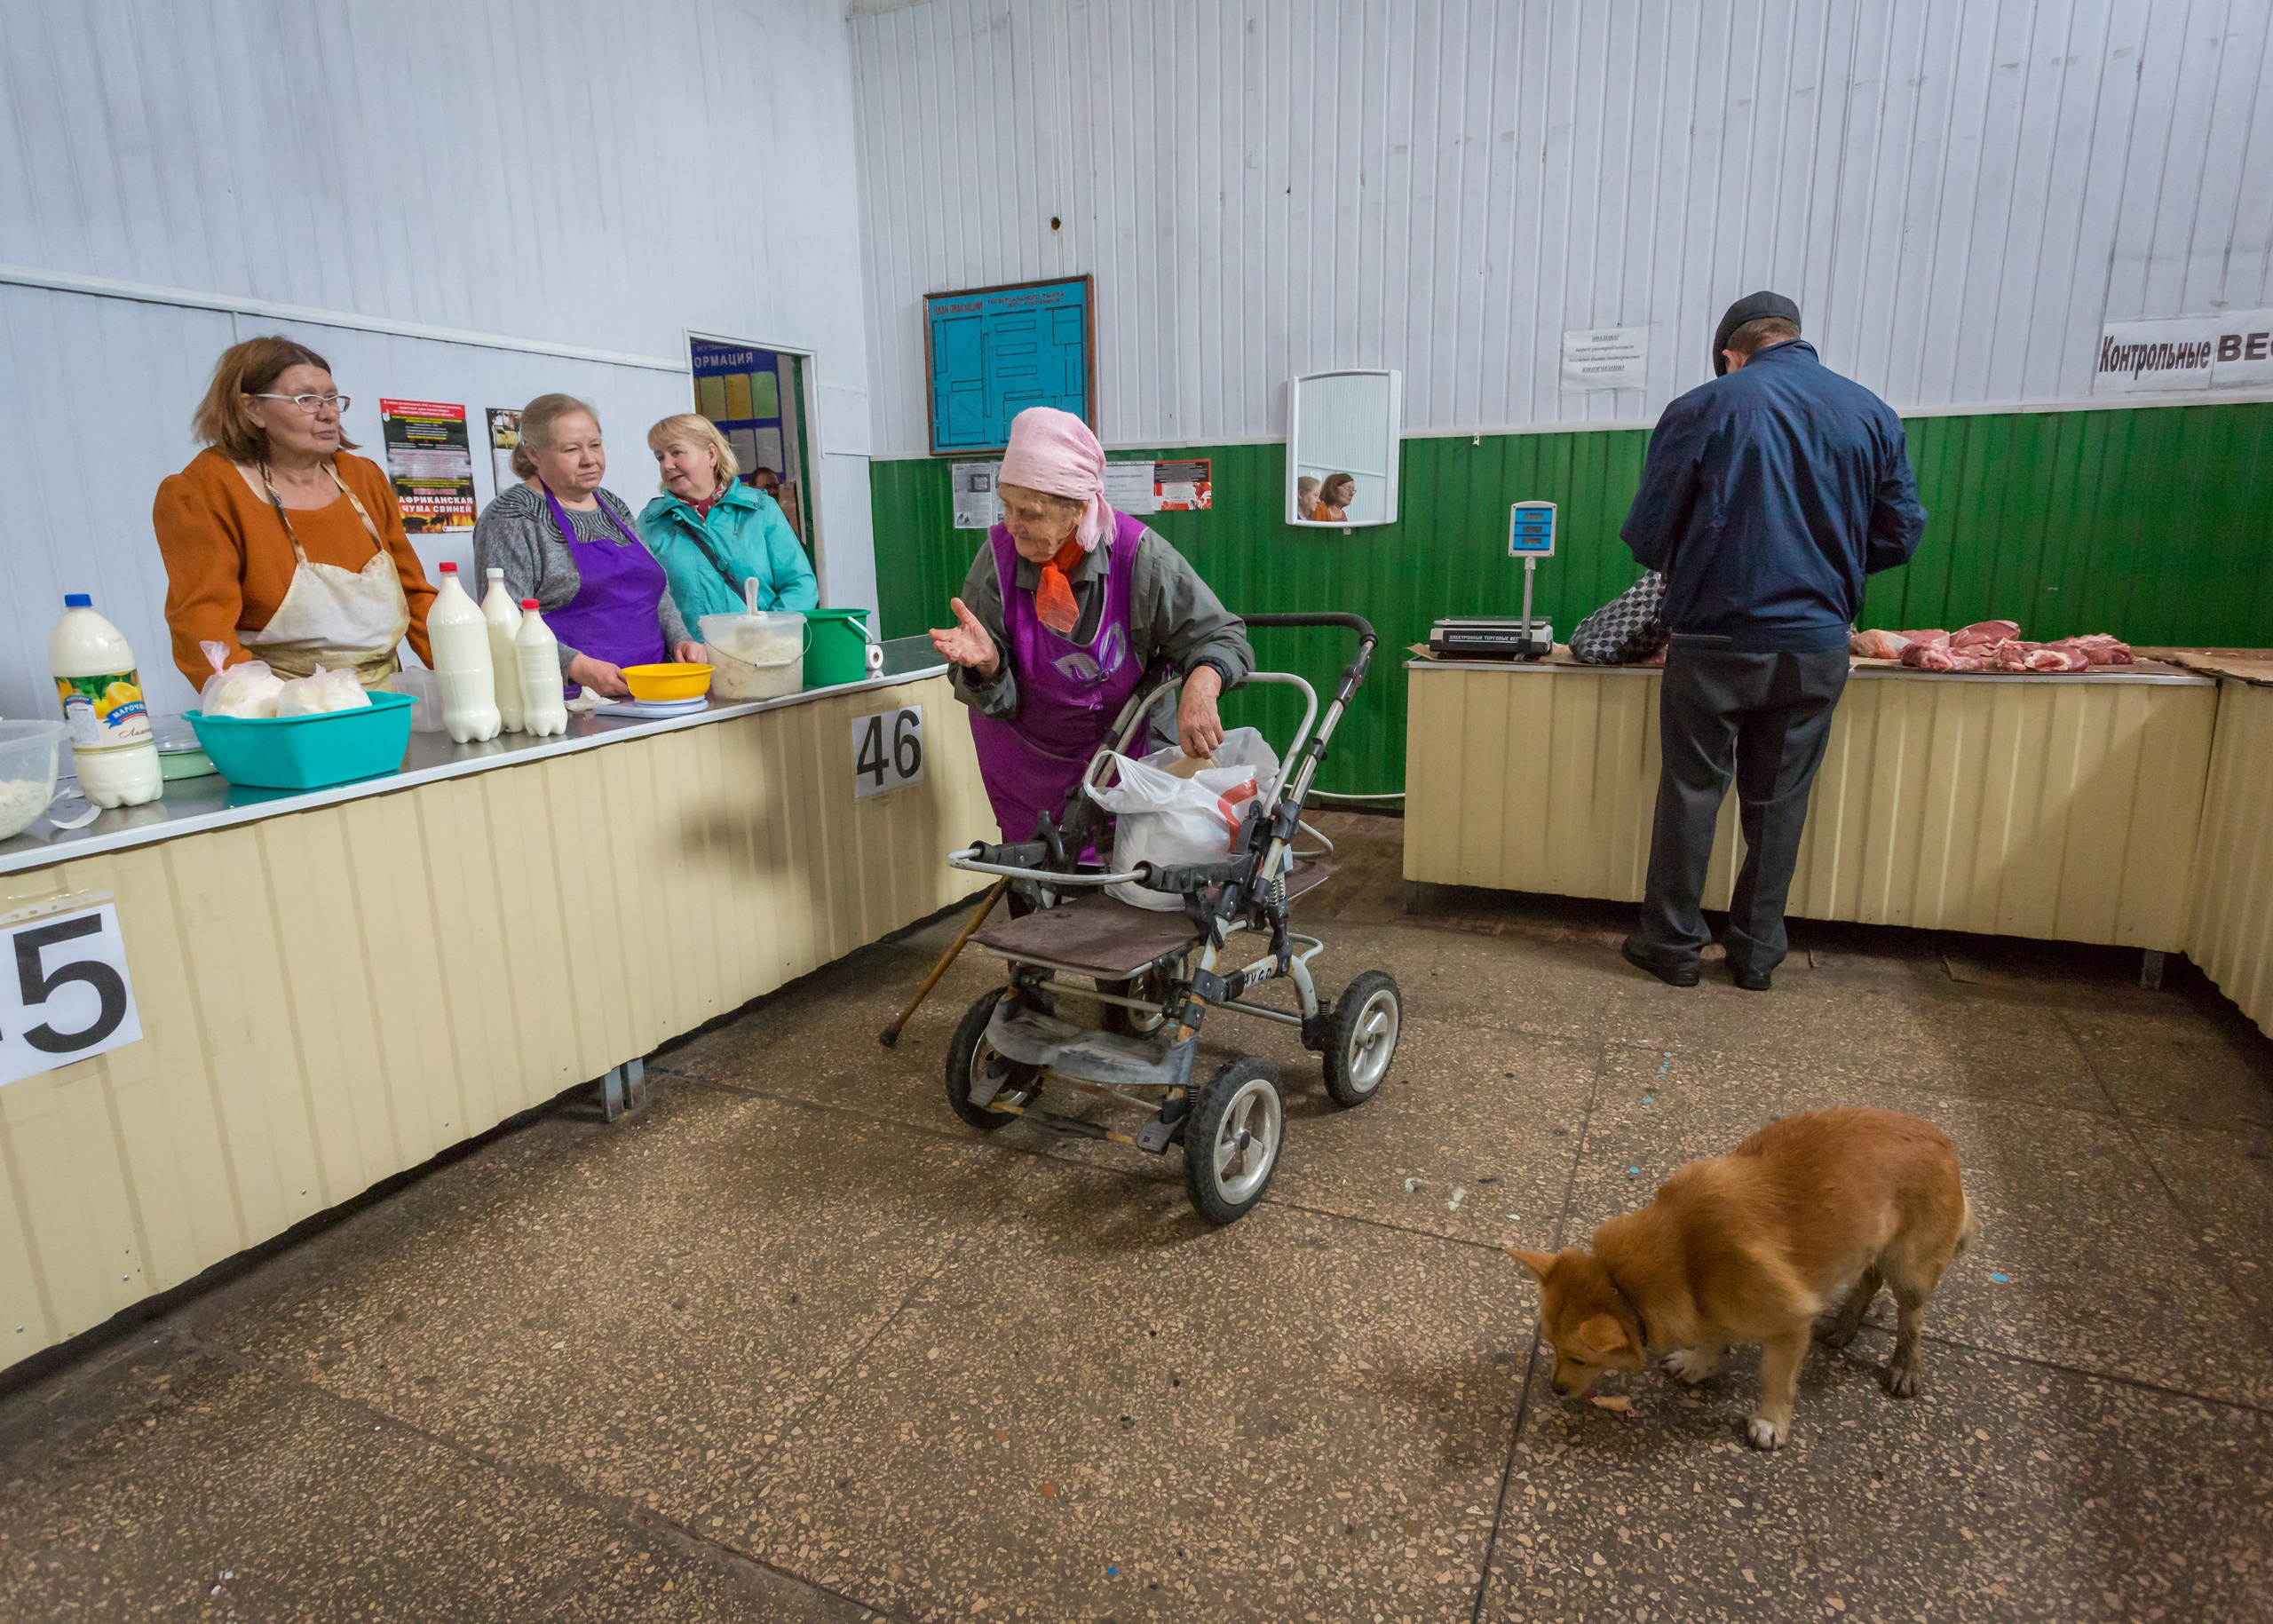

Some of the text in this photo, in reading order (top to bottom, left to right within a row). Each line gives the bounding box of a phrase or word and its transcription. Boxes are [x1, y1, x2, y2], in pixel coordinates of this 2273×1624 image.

[933, 305, 948, 315] ПЛАН
[2098, 332, 2273, 381] Контрольные ВЕ
[399, 495, 473, 504] АФРИКАНСКАЯ
[432, 504, 471, 513] СВИНЕЙ
[857, 709, 921, 787] 46
[0, 913, 127, 1054] 5
